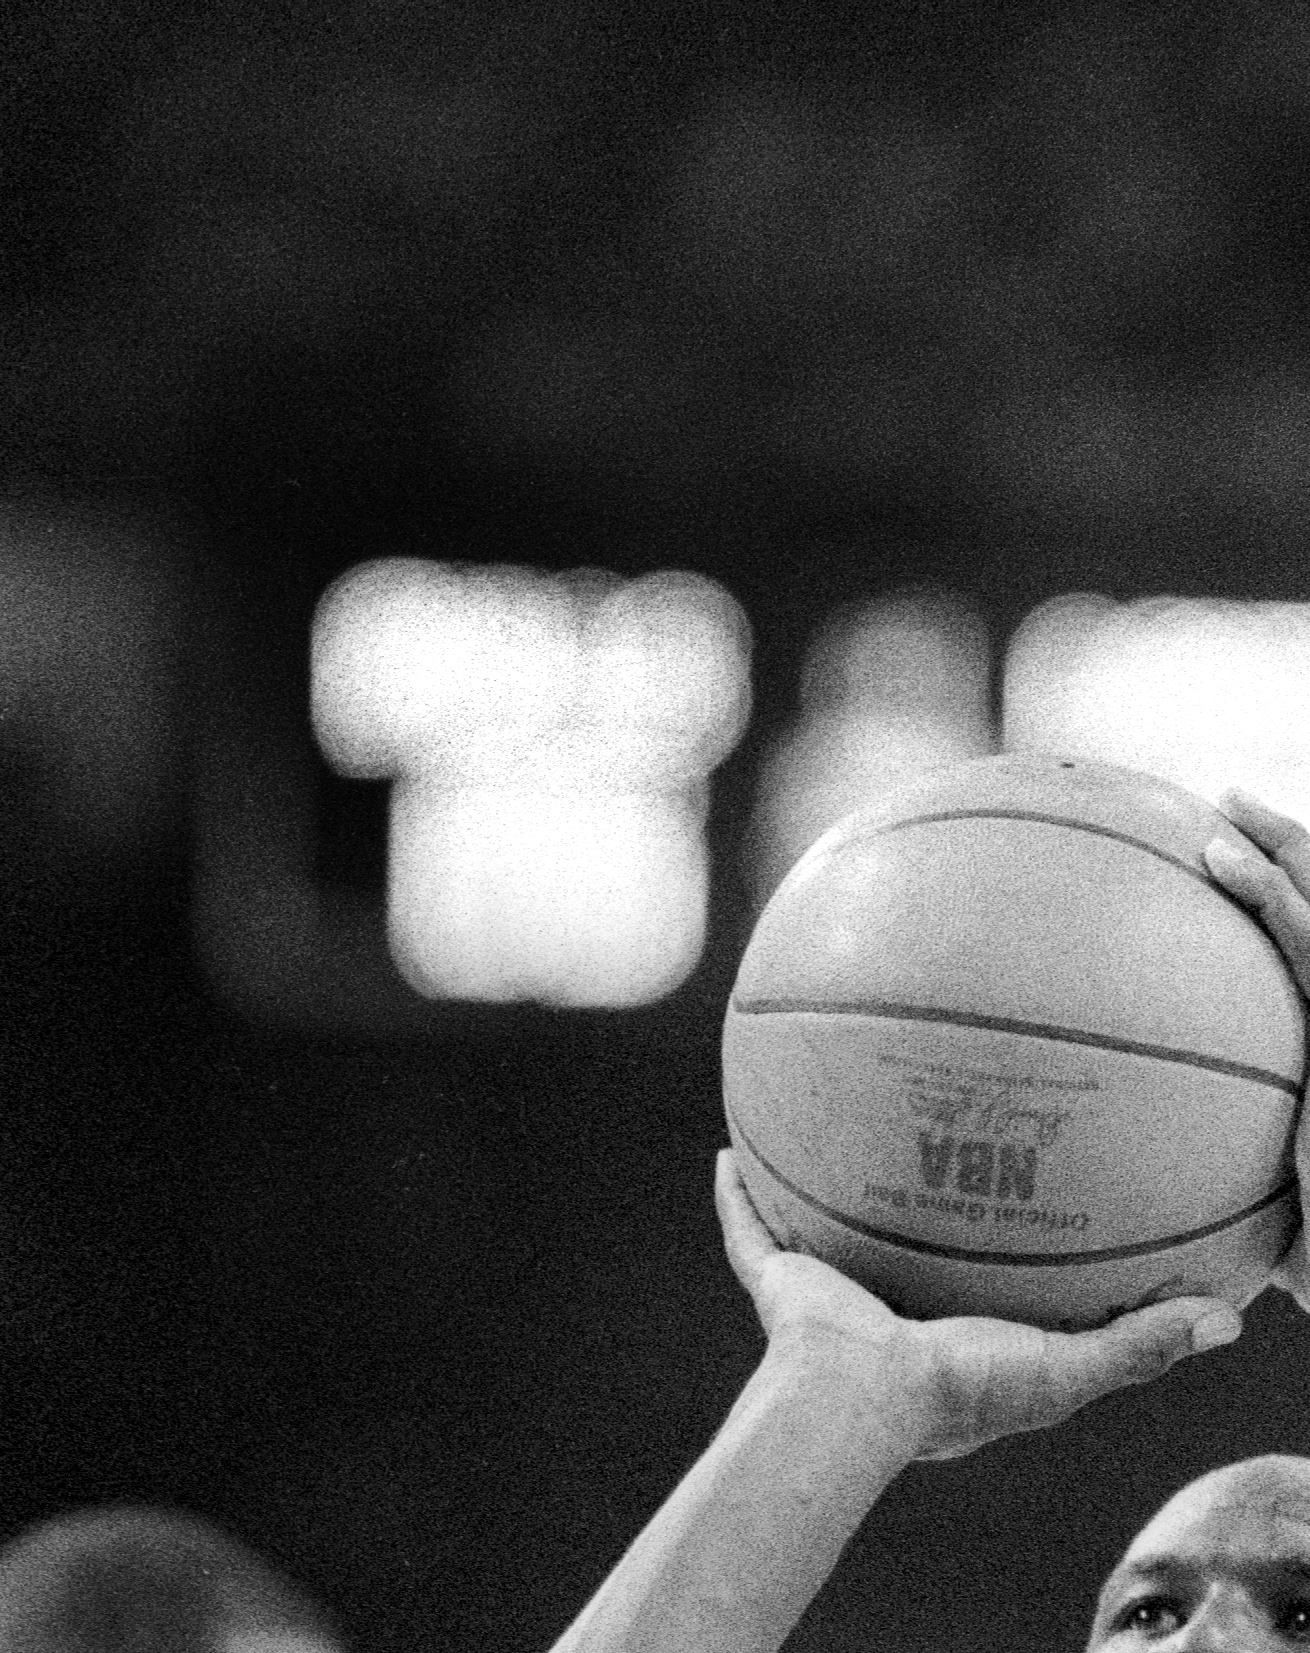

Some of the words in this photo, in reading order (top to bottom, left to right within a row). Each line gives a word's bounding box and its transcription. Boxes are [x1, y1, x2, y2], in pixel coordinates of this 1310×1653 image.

[916, 1131, 1038, 1202] NBA
[914, 1193, 987, 1223] Game
[993, 1207, 1091, 1232] Official
